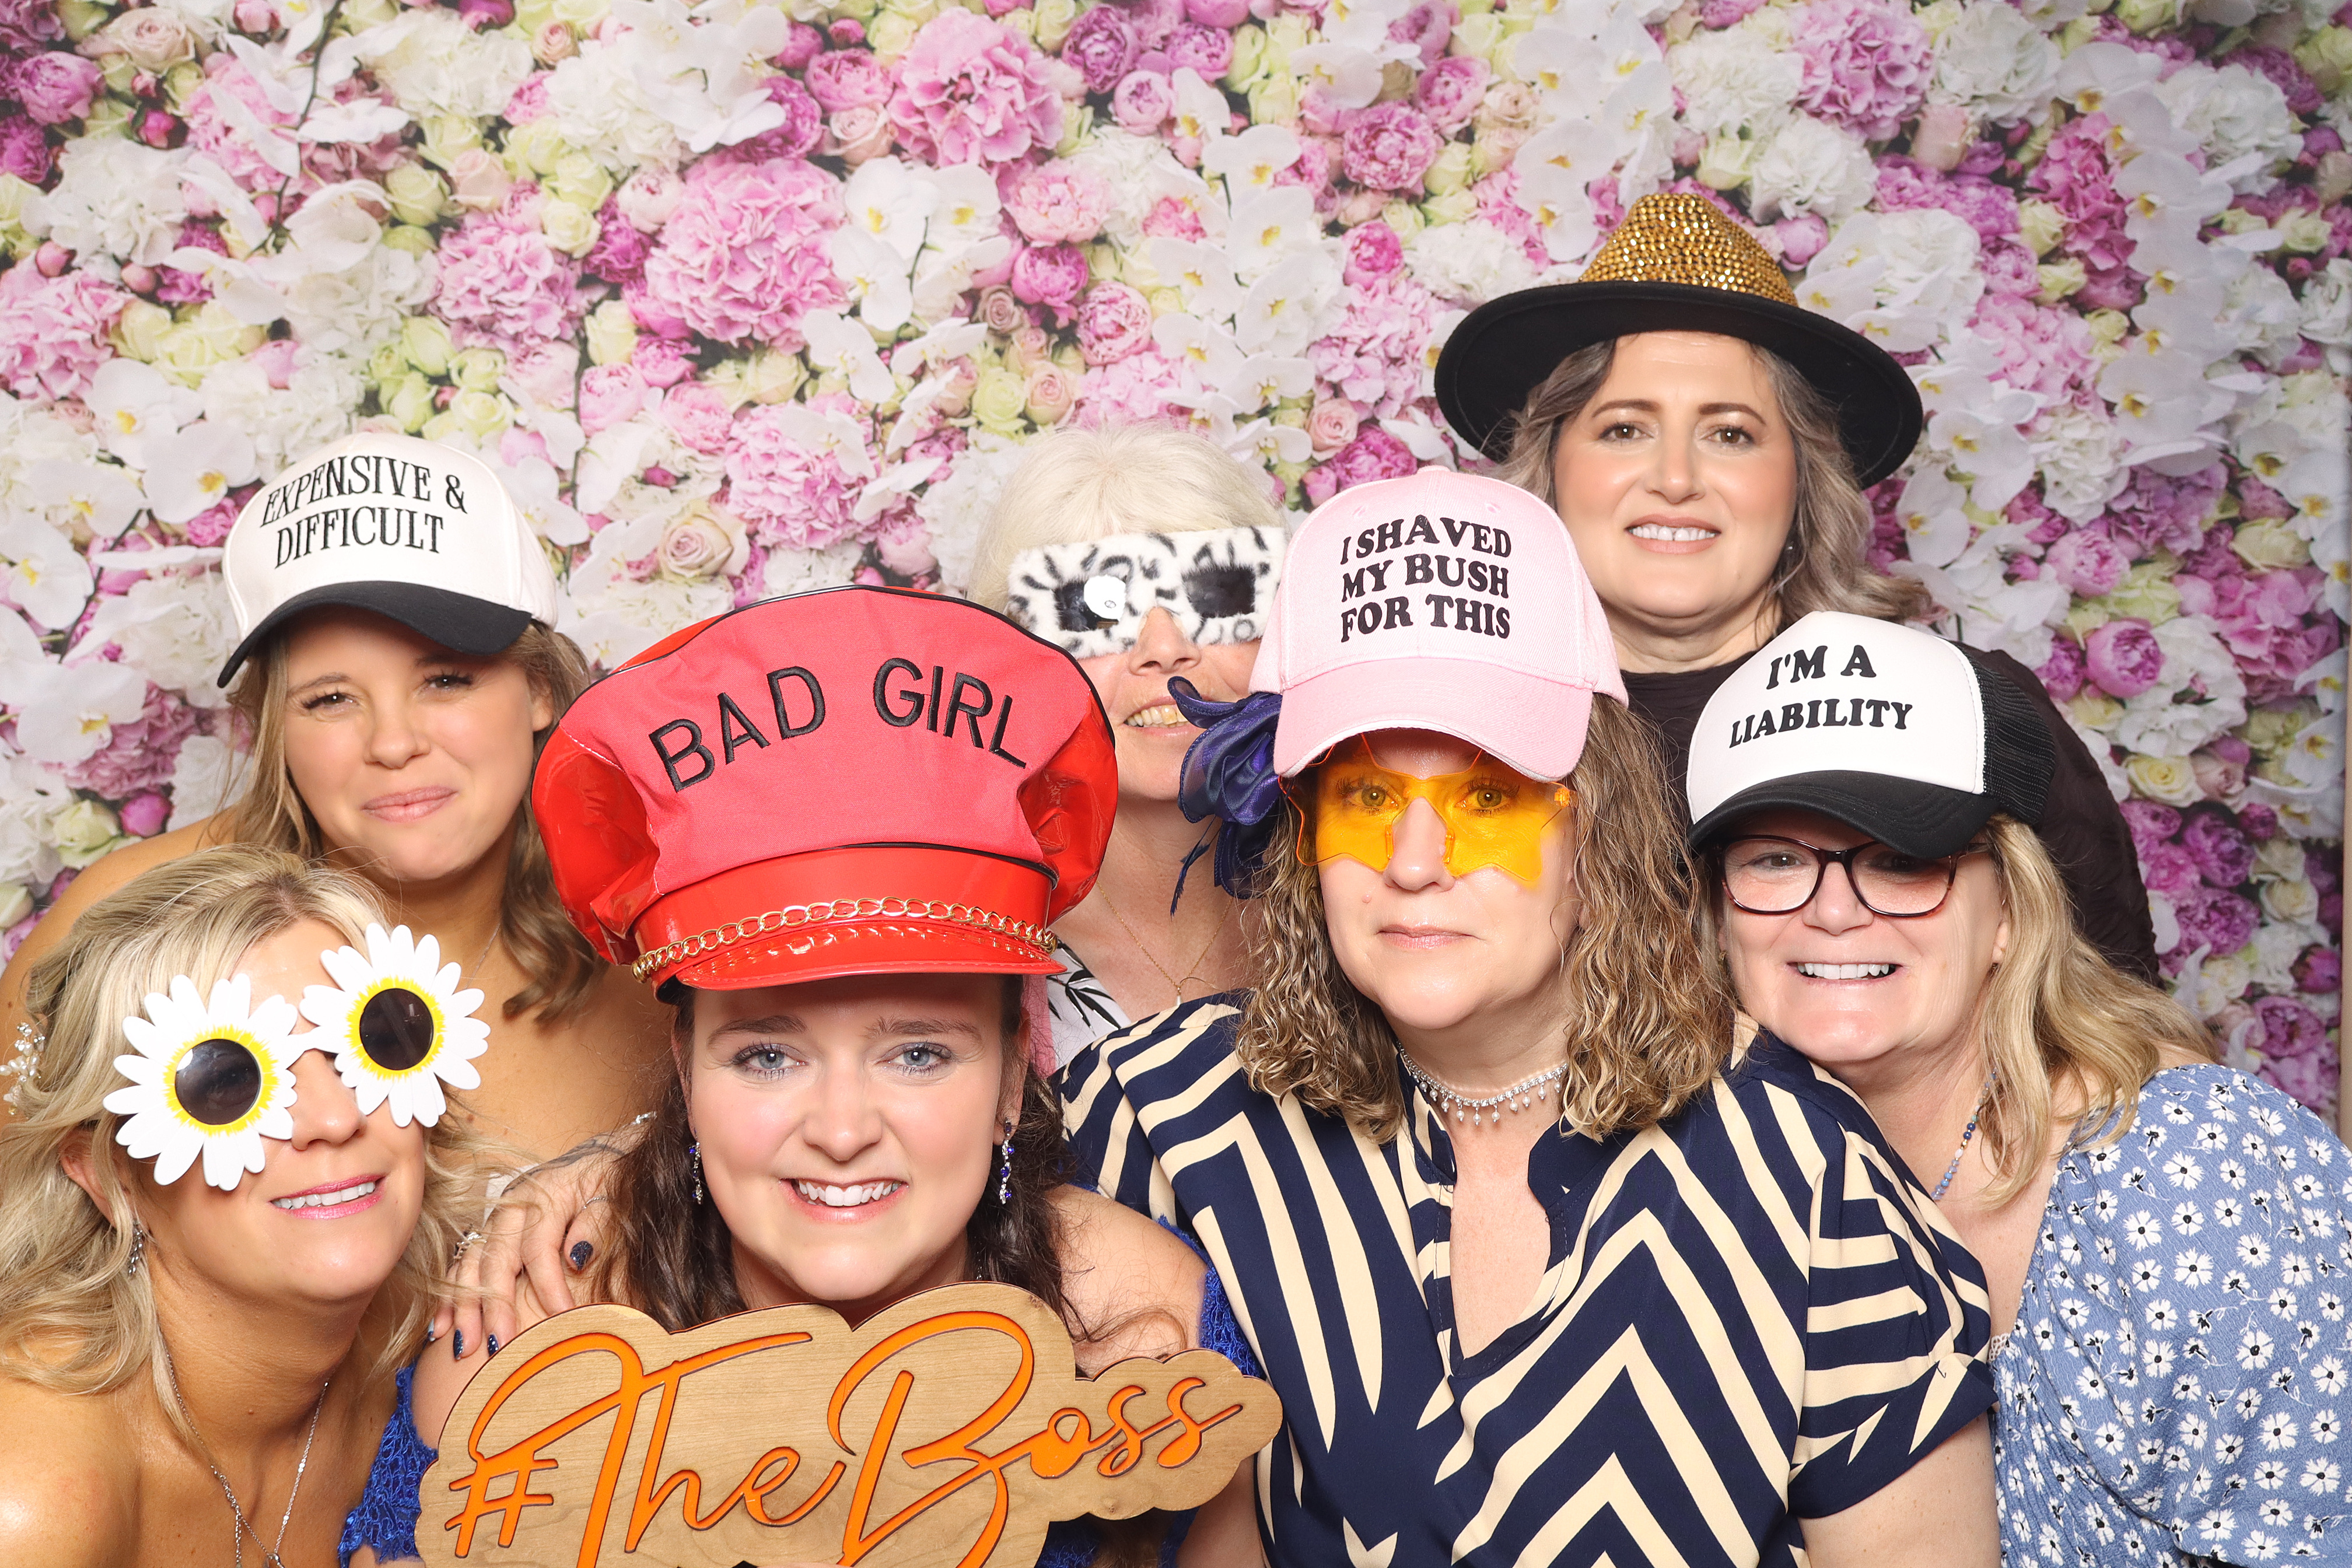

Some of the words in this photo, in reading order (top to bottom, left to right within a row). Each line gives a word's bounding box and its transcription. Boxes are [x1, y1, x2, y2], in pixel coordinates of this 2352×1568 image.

[260, 456, 430, 527] EXPENSIVE
[446, 475, 467, 514] &
[275, 506, 443, 568] DIFFICULT
[1340, 537, 1352, 564] I
[1356, 514, 1511, 558] SHAVED
[1341, 560, 1394, 602] MY
[1404, 554, 1508, 598] BUSH
[1341, 596, 1413, 643] FOR
[1425, 594, 1510, 639] THIS
[1766, 646, 1828, 690] I'M
[1840, 645, 1877, 678] A
[649, 666, 825, 792] BAD
[874, 657, 1026, 768] GIRL
[1729, 698, 1913, 748] LIABILITY
